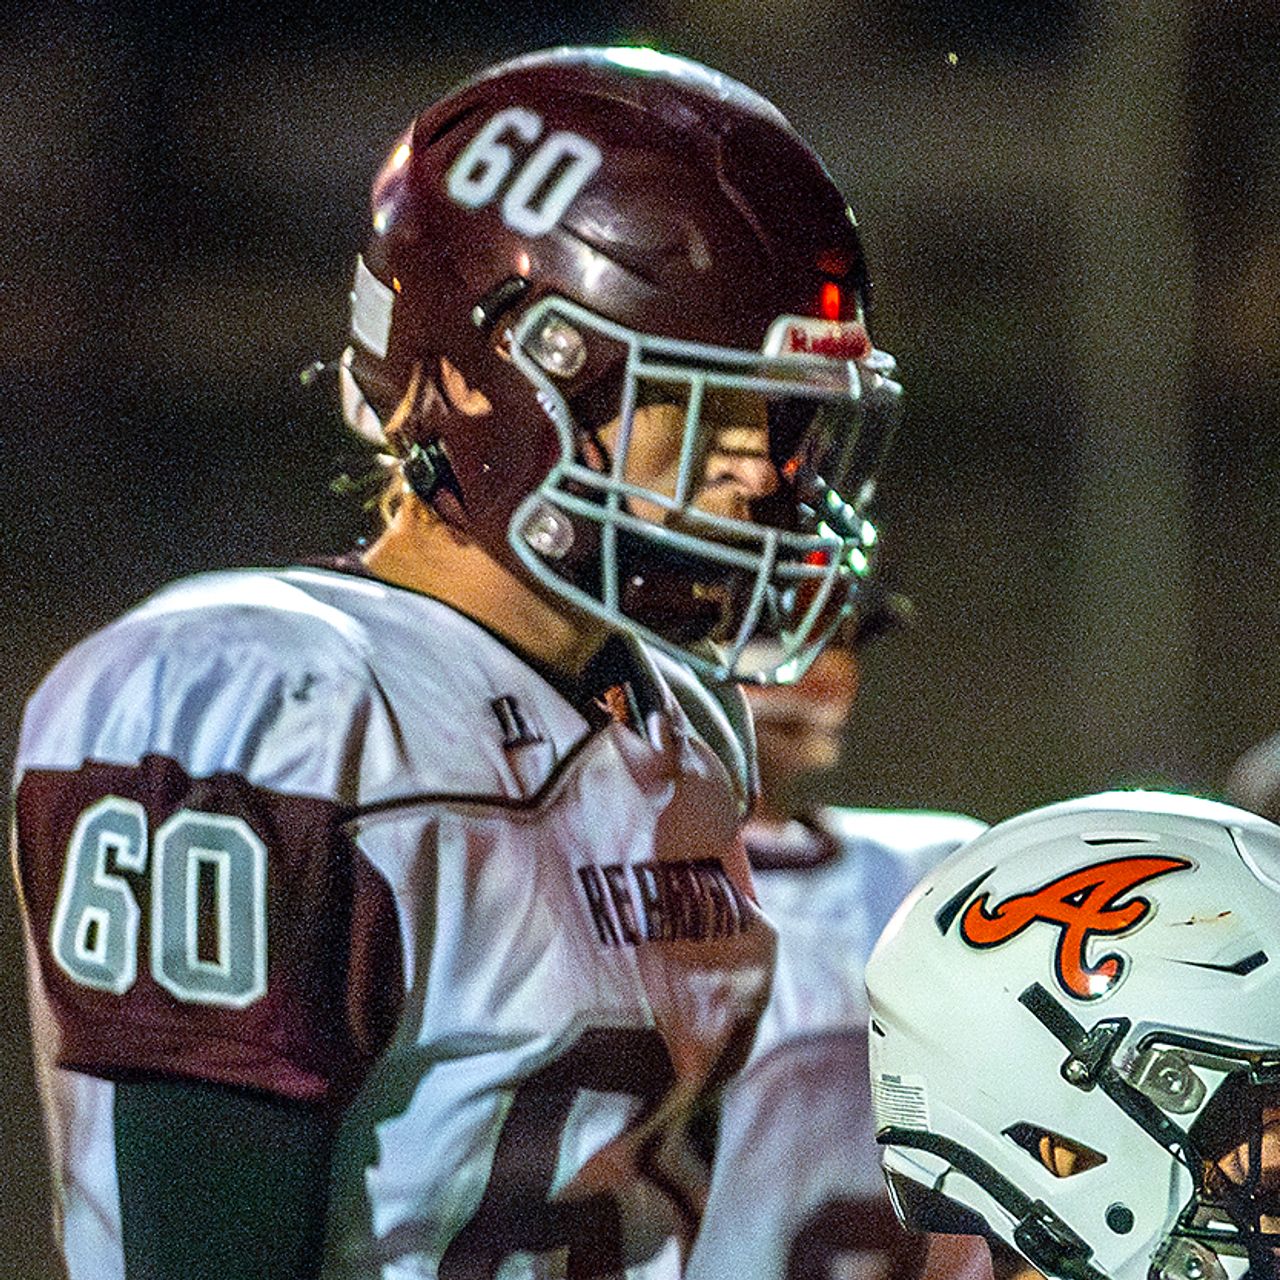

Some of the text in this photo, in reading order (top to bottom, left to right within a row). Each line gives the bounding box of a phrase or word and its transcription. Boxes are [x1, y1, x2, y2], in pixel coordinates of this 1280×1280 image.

[447, 106, 602, 238] 60
[52, 794, 268, 1009] 60
[957, 853, 1198, 1002] A
